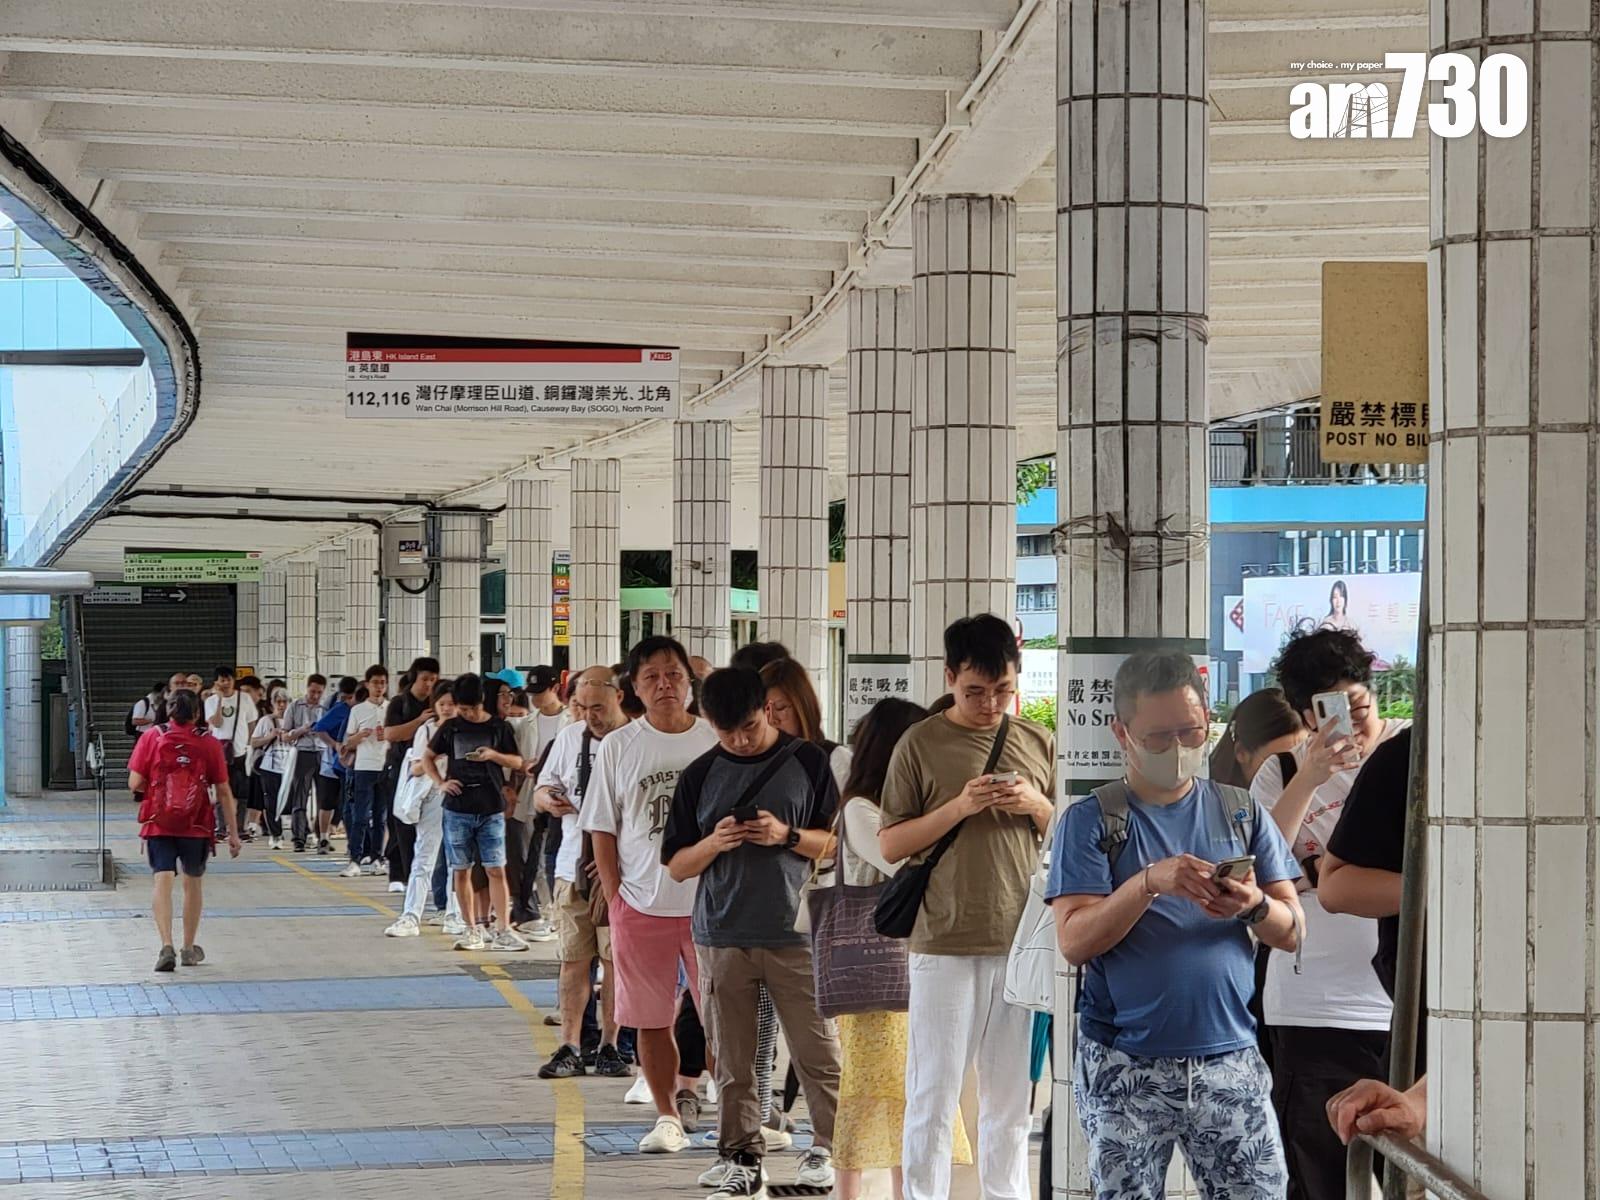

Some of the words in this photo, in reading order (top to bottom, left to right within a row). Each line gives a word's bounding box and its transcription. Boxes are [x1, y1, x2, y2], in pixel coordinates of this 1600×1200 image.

[359, 363, 390, 373] 英皇道
[346, 391, 411, 408] 112,116
[415, 404, 433, 412] Wan
[434, 404, 452, 412] Chai
[454, 404, 489, 413] (Morrison
[490, 404, 503, 412] Hill
[504, 405, 529, 413] Road),
[530, 405, 570, 414] Causeway
[571, 405, 586, 414] Bay
[587, 405, 620, 414] (SOGO),
[622, 405, 643, 413] North
[644, 405, 664, 413] Point
[1326, 431, 1367, 446] POST
[1376, 432, 1397, 446] NO
[1067, 709, 1086, 726] No
